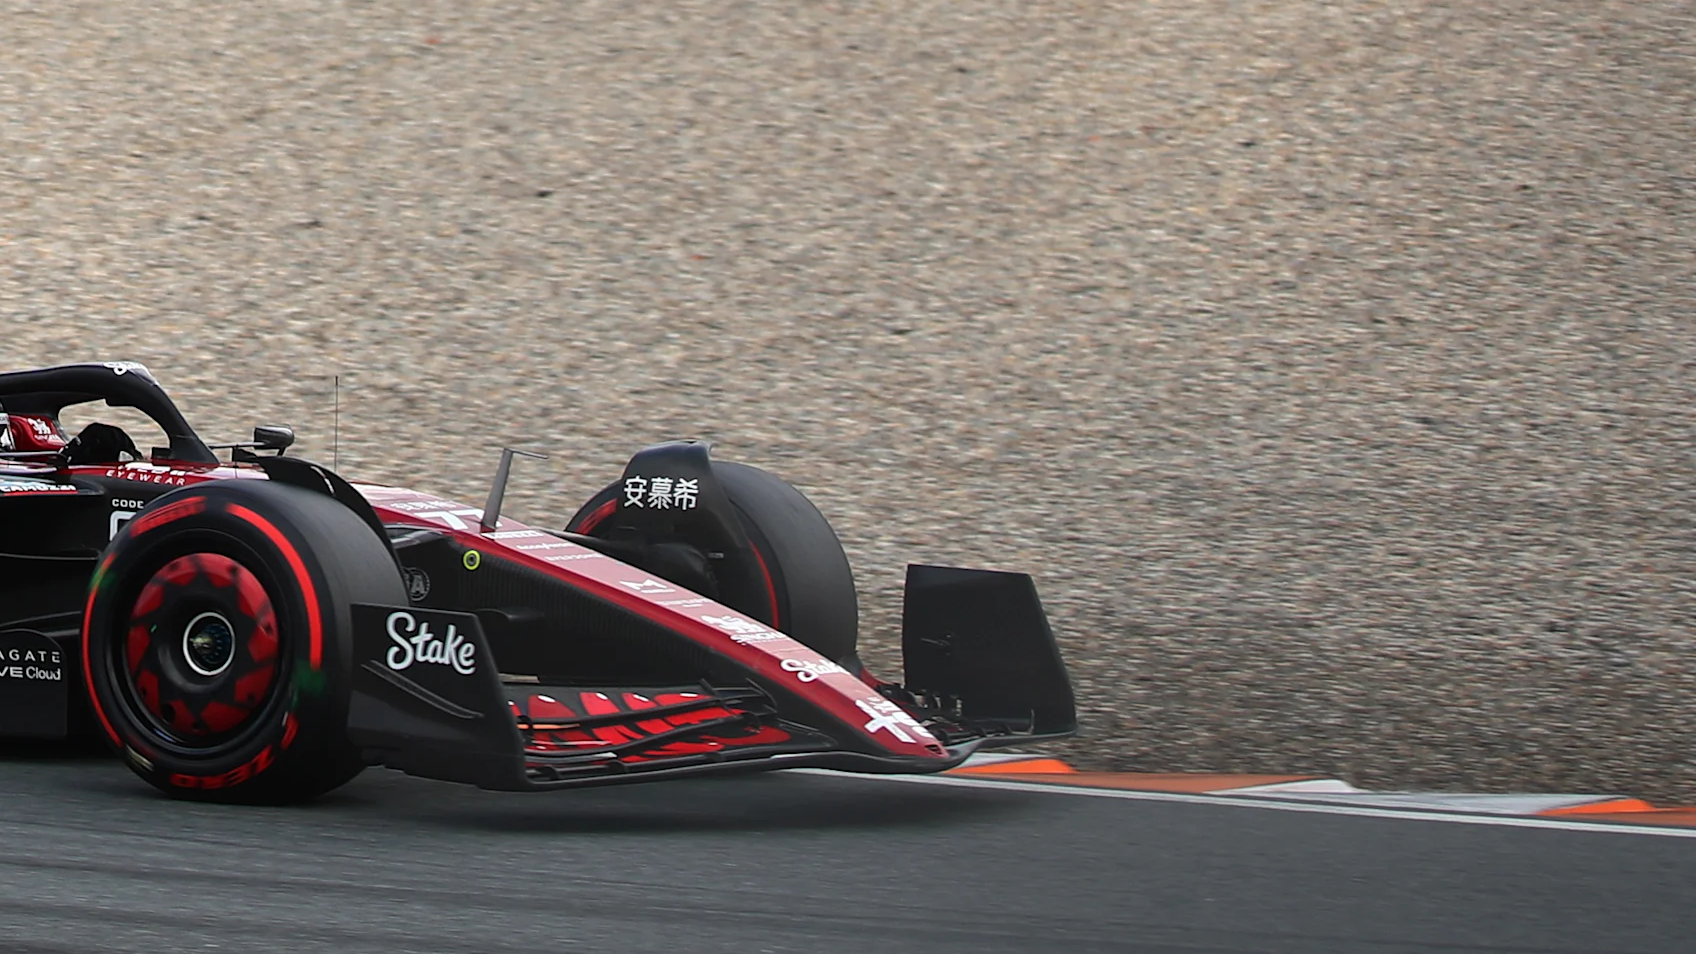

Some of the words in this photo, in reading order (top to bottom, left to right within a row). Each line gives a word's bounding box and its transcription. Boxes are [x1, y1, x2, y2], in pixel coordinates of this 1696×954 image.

[106, 469, 186, 486] EYEWEAR
[623, 475, 699, 510] 安慕希
[111, 498, 145, 509] CODE
[386, 611, 477, 675] Stake
[25, 666, 61, 681] Cloud
